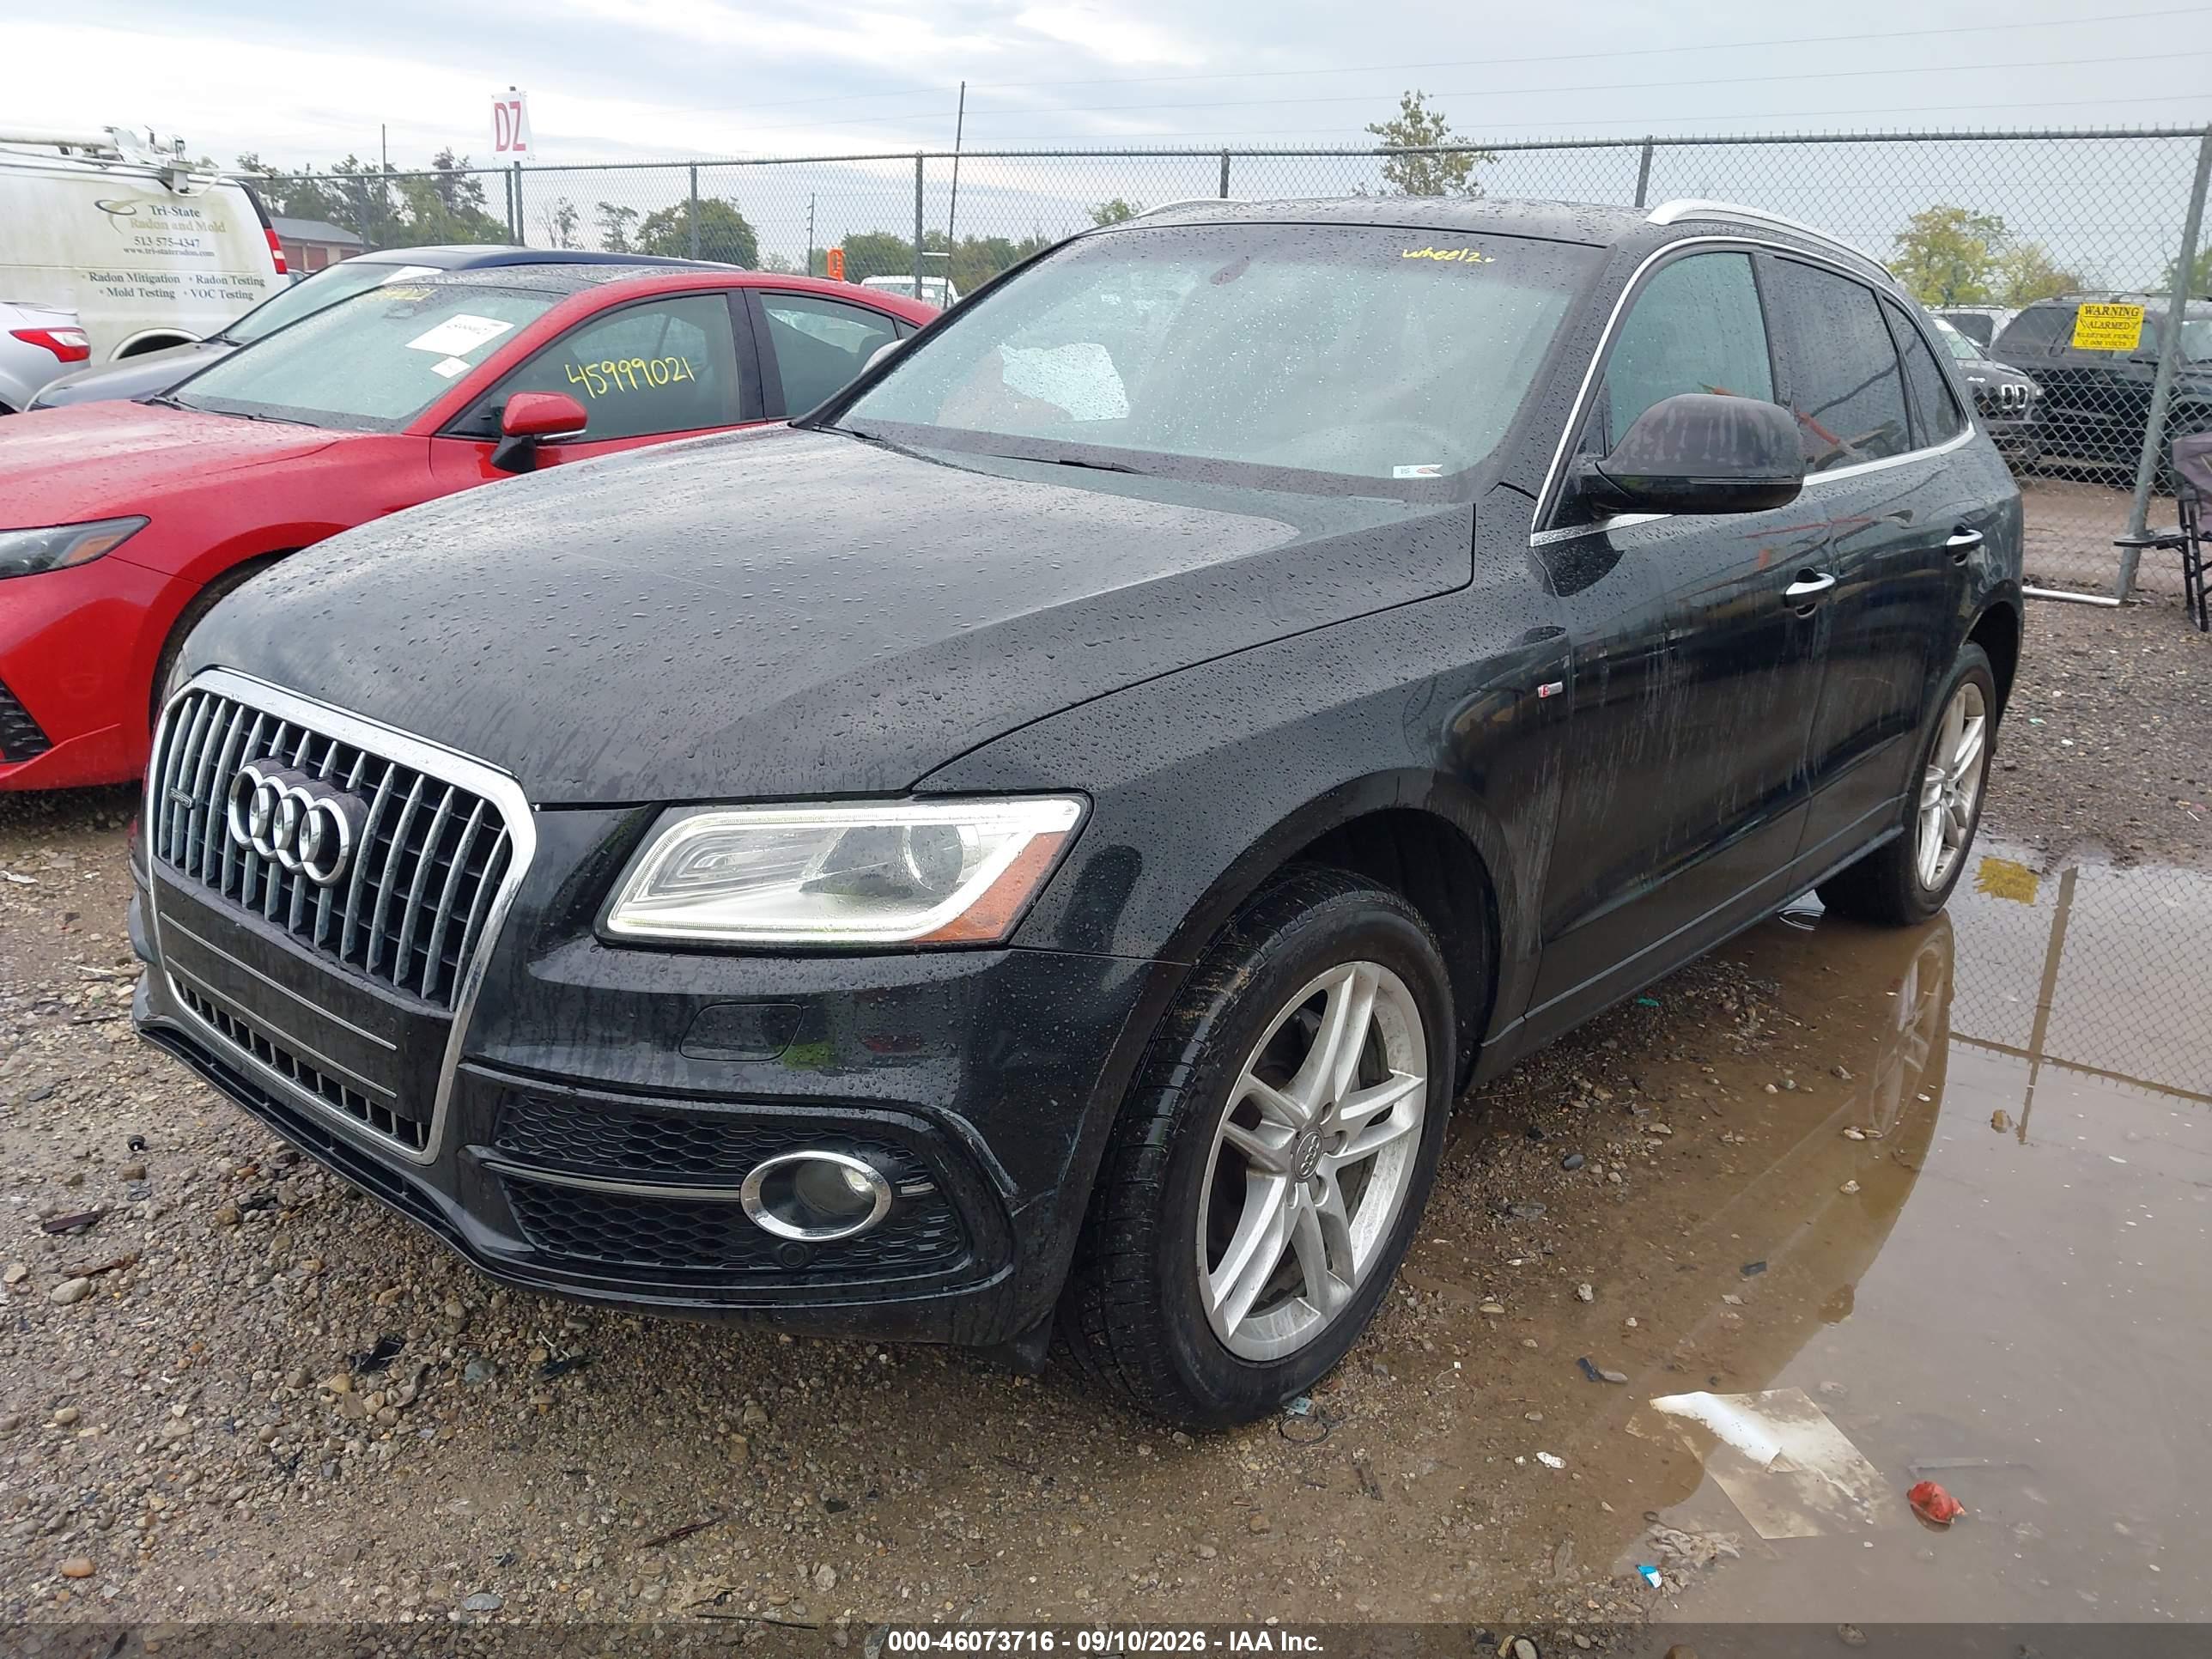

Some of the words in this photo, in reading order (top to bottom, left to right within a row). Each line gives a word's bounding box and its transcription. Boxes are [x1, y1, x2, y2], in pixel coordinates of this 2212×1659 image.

[148, 204, 201, 218] Tri-State
[130, 217, 169, 230] Radon
[171, 221, 194, 232] and
[195, 221, 227, 233] Mold
[134, 235, 153, 246] 513
[156, 236, 200, 247] 575-4347
[88, 271, 125, 283] Radon
[125, 272, 180, 284] Mitigation
[196, 275, 228, 285] Radon
[229, 276, 265, 288] Testing
[106, 287, 135, 297] Mold
[137, 288, 176, 300] Testing
[190, 289, 216, 299] VOC
[218, 289, 254, 301] Testing
[2084, 305, 2141, 317] WARNING
[2089, 320, 2131, 330] ALARMED
[564, 356, 696, 399] 45999021
